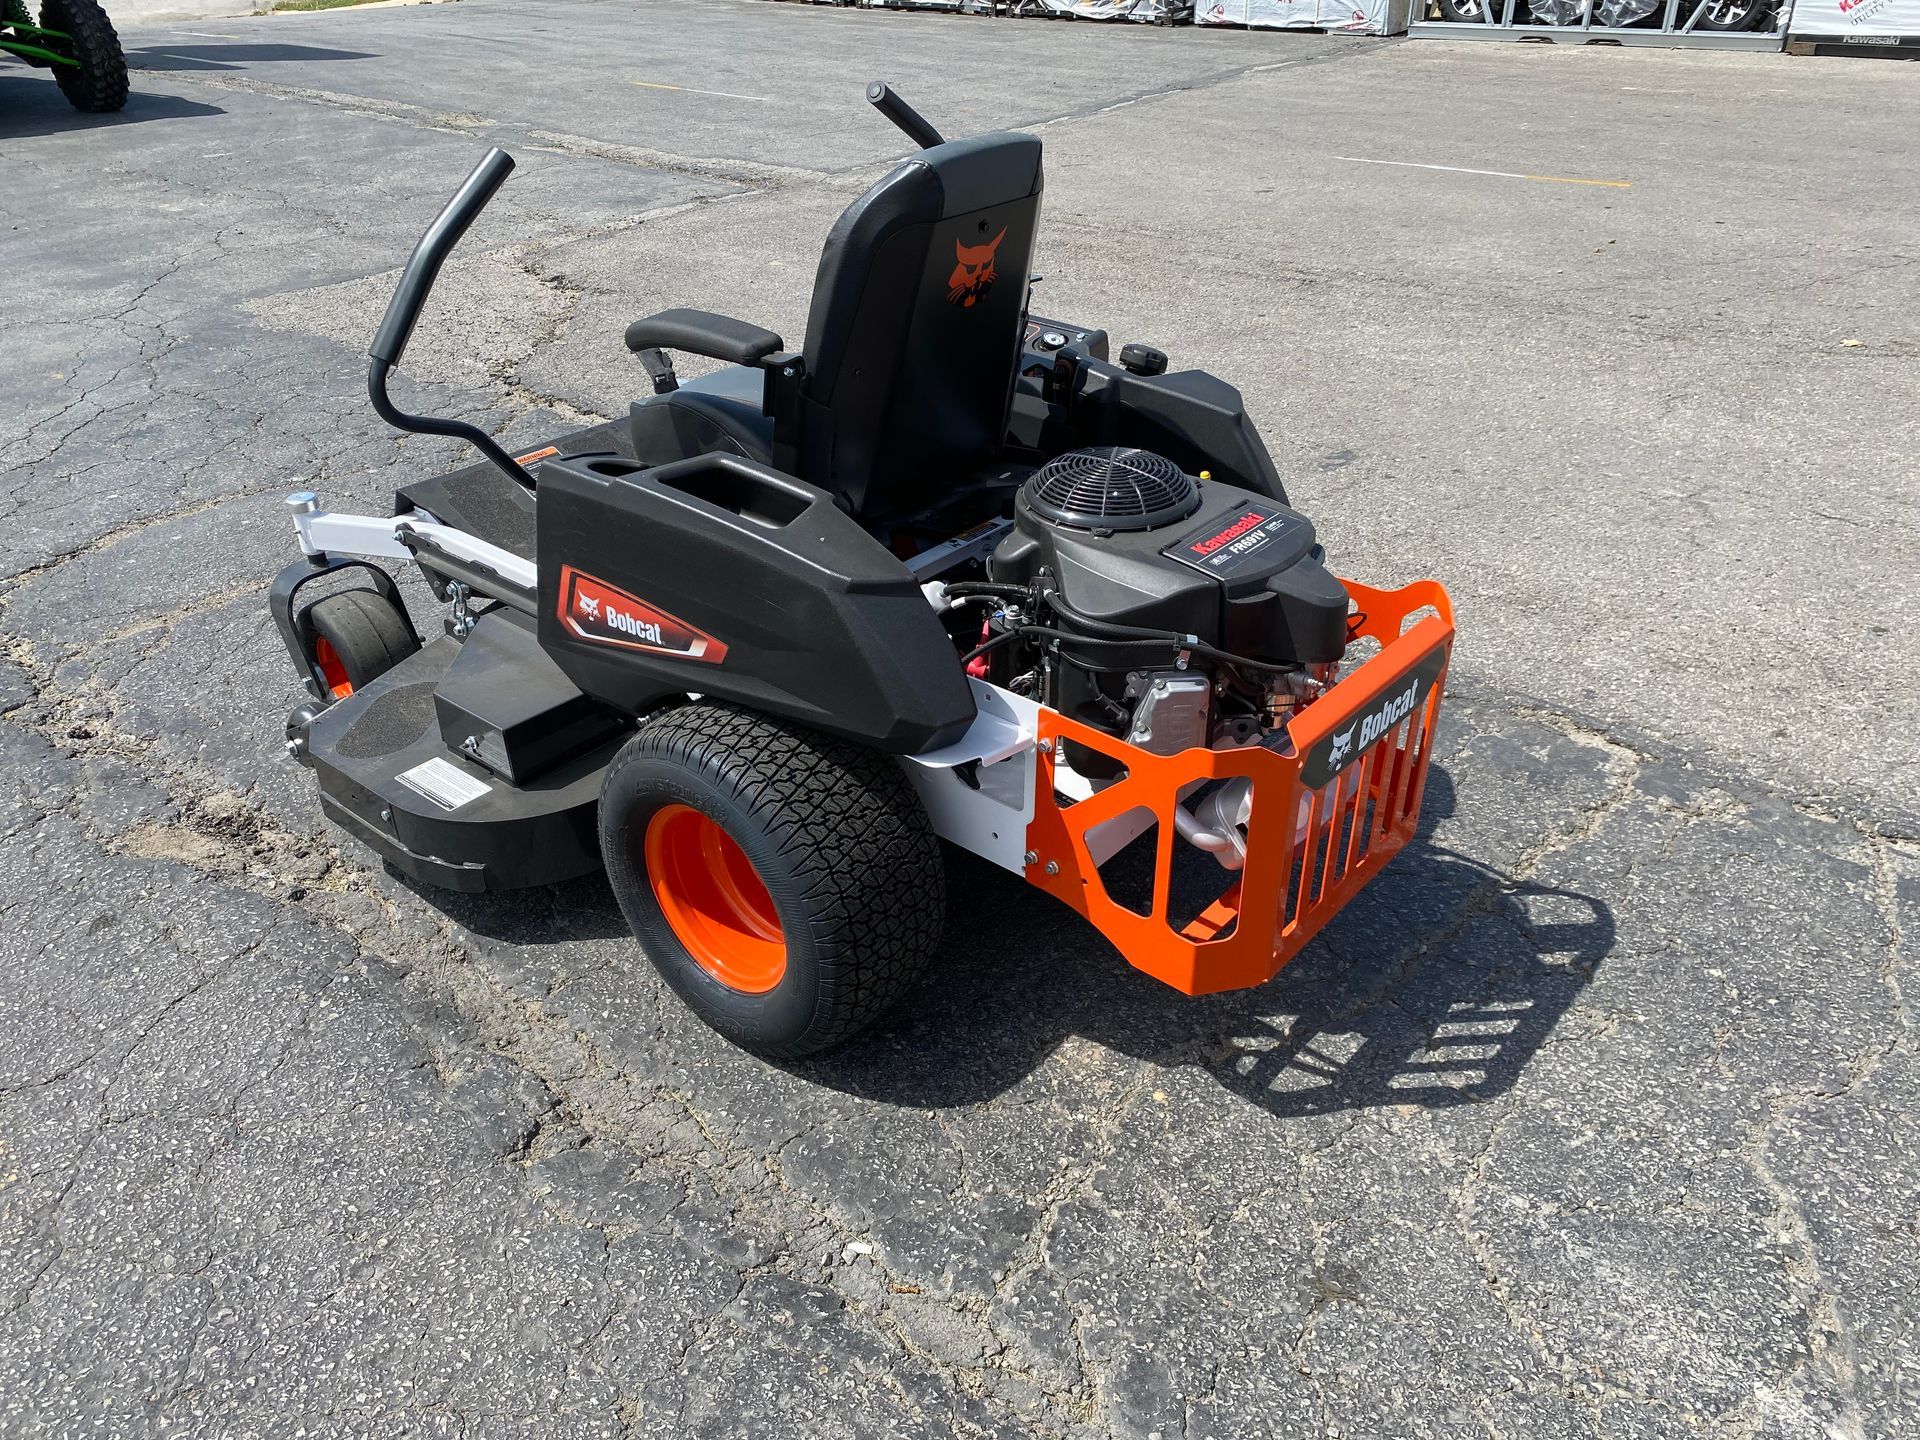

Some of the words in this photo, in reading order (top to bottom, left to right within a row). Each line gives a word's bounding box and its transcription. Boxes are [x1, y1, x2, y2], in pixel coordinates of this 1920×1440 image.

[1851, 1, 1885, 26] UTILITY
[1842, 35, 1900, 45] Kawasaki
[517, 450, 548, 464] WARNING
[1190, 512, 1265, 555] Kawasaki
[1228, 529, 1267, 554] FR691V
[605, 605, 662, 645] Bobcat
[1357, 678, 1419, 751] Bobcat
